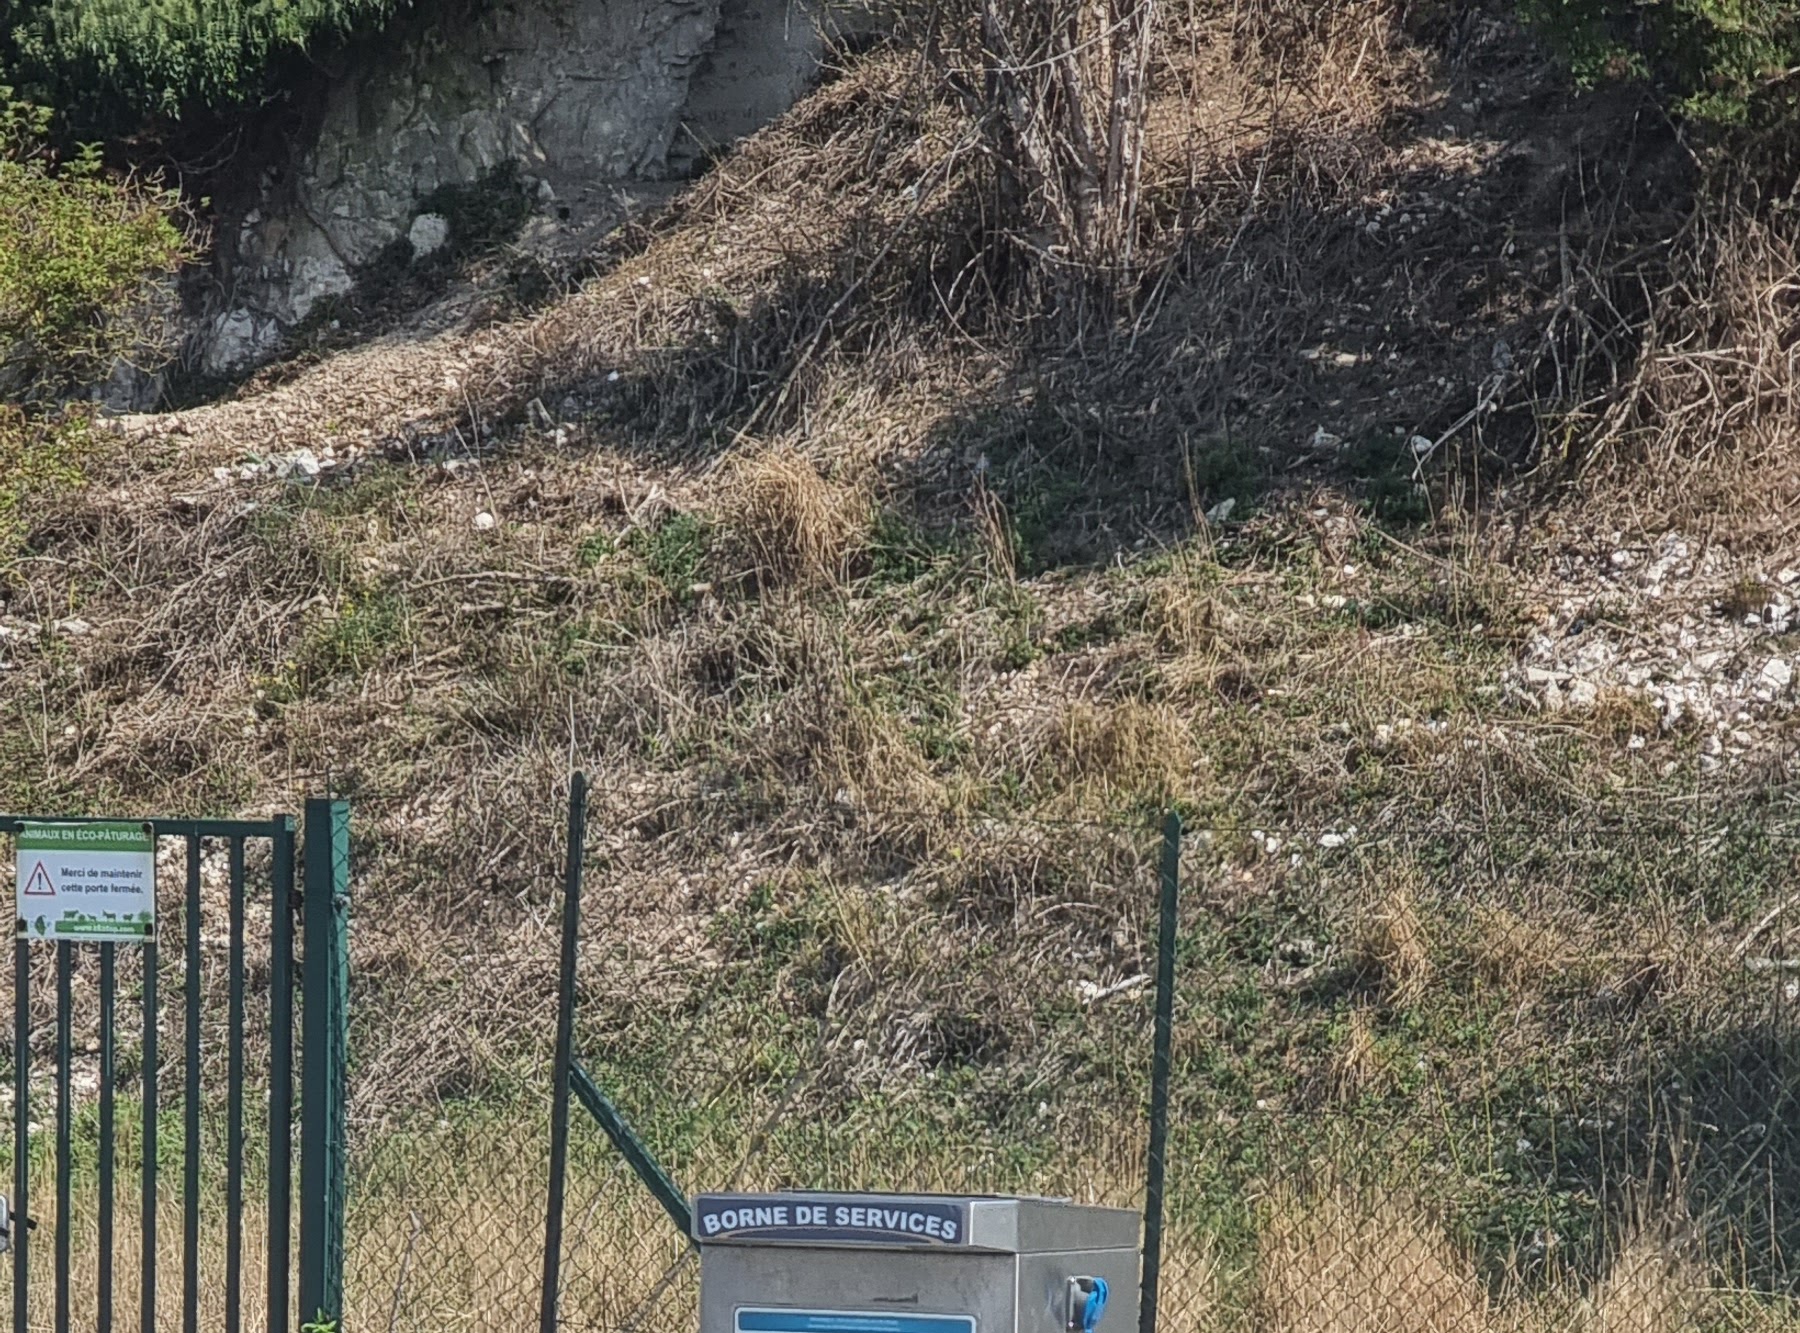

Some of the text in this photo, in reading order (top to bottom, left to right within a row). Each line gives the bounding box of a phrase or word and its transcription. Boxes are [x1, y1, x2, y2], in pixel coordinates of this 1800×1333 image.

[61, 829, 75, 841] EN
[61, 867, 143, 879] Merci de maintenir
[61, 882, 144, 895] cette porte fermée.
[703, 1206, 957, 1240] BORNE DE SERVICES
